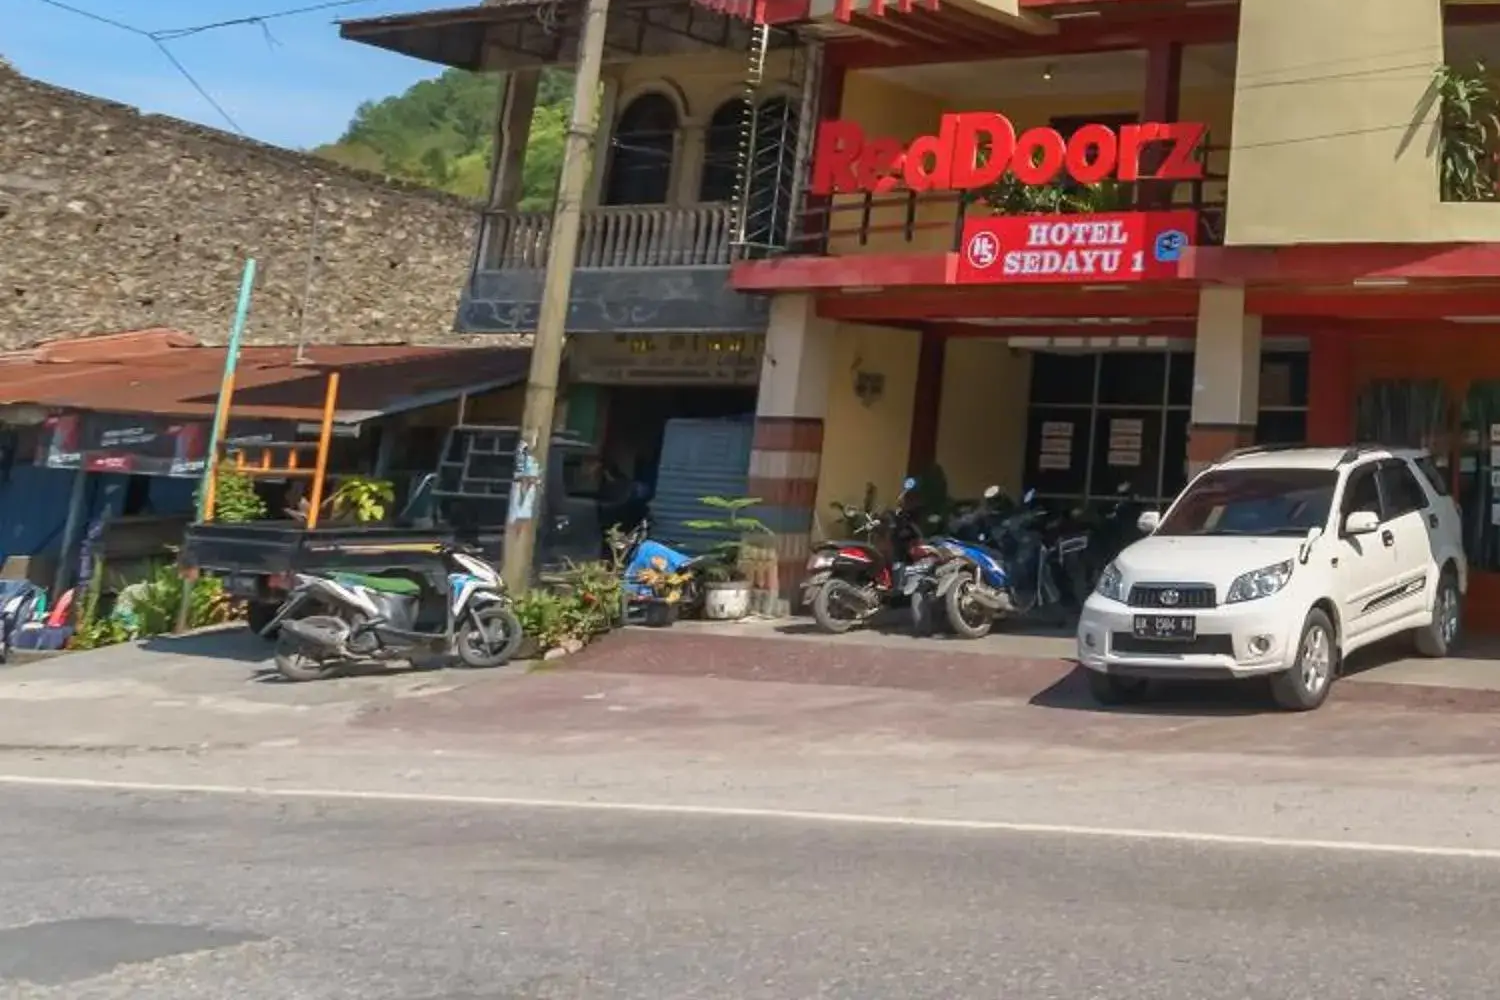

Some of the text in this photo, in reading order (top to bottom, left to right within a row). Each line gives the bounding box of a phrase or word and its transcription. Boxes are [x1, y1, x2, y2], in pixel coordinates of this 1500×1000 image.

[812, 112, 1205, 196] RedDoorz
[1027, 221, 1129, 247] HOTEL
[1003, 249, 1146, 276] SEDAYU 1
